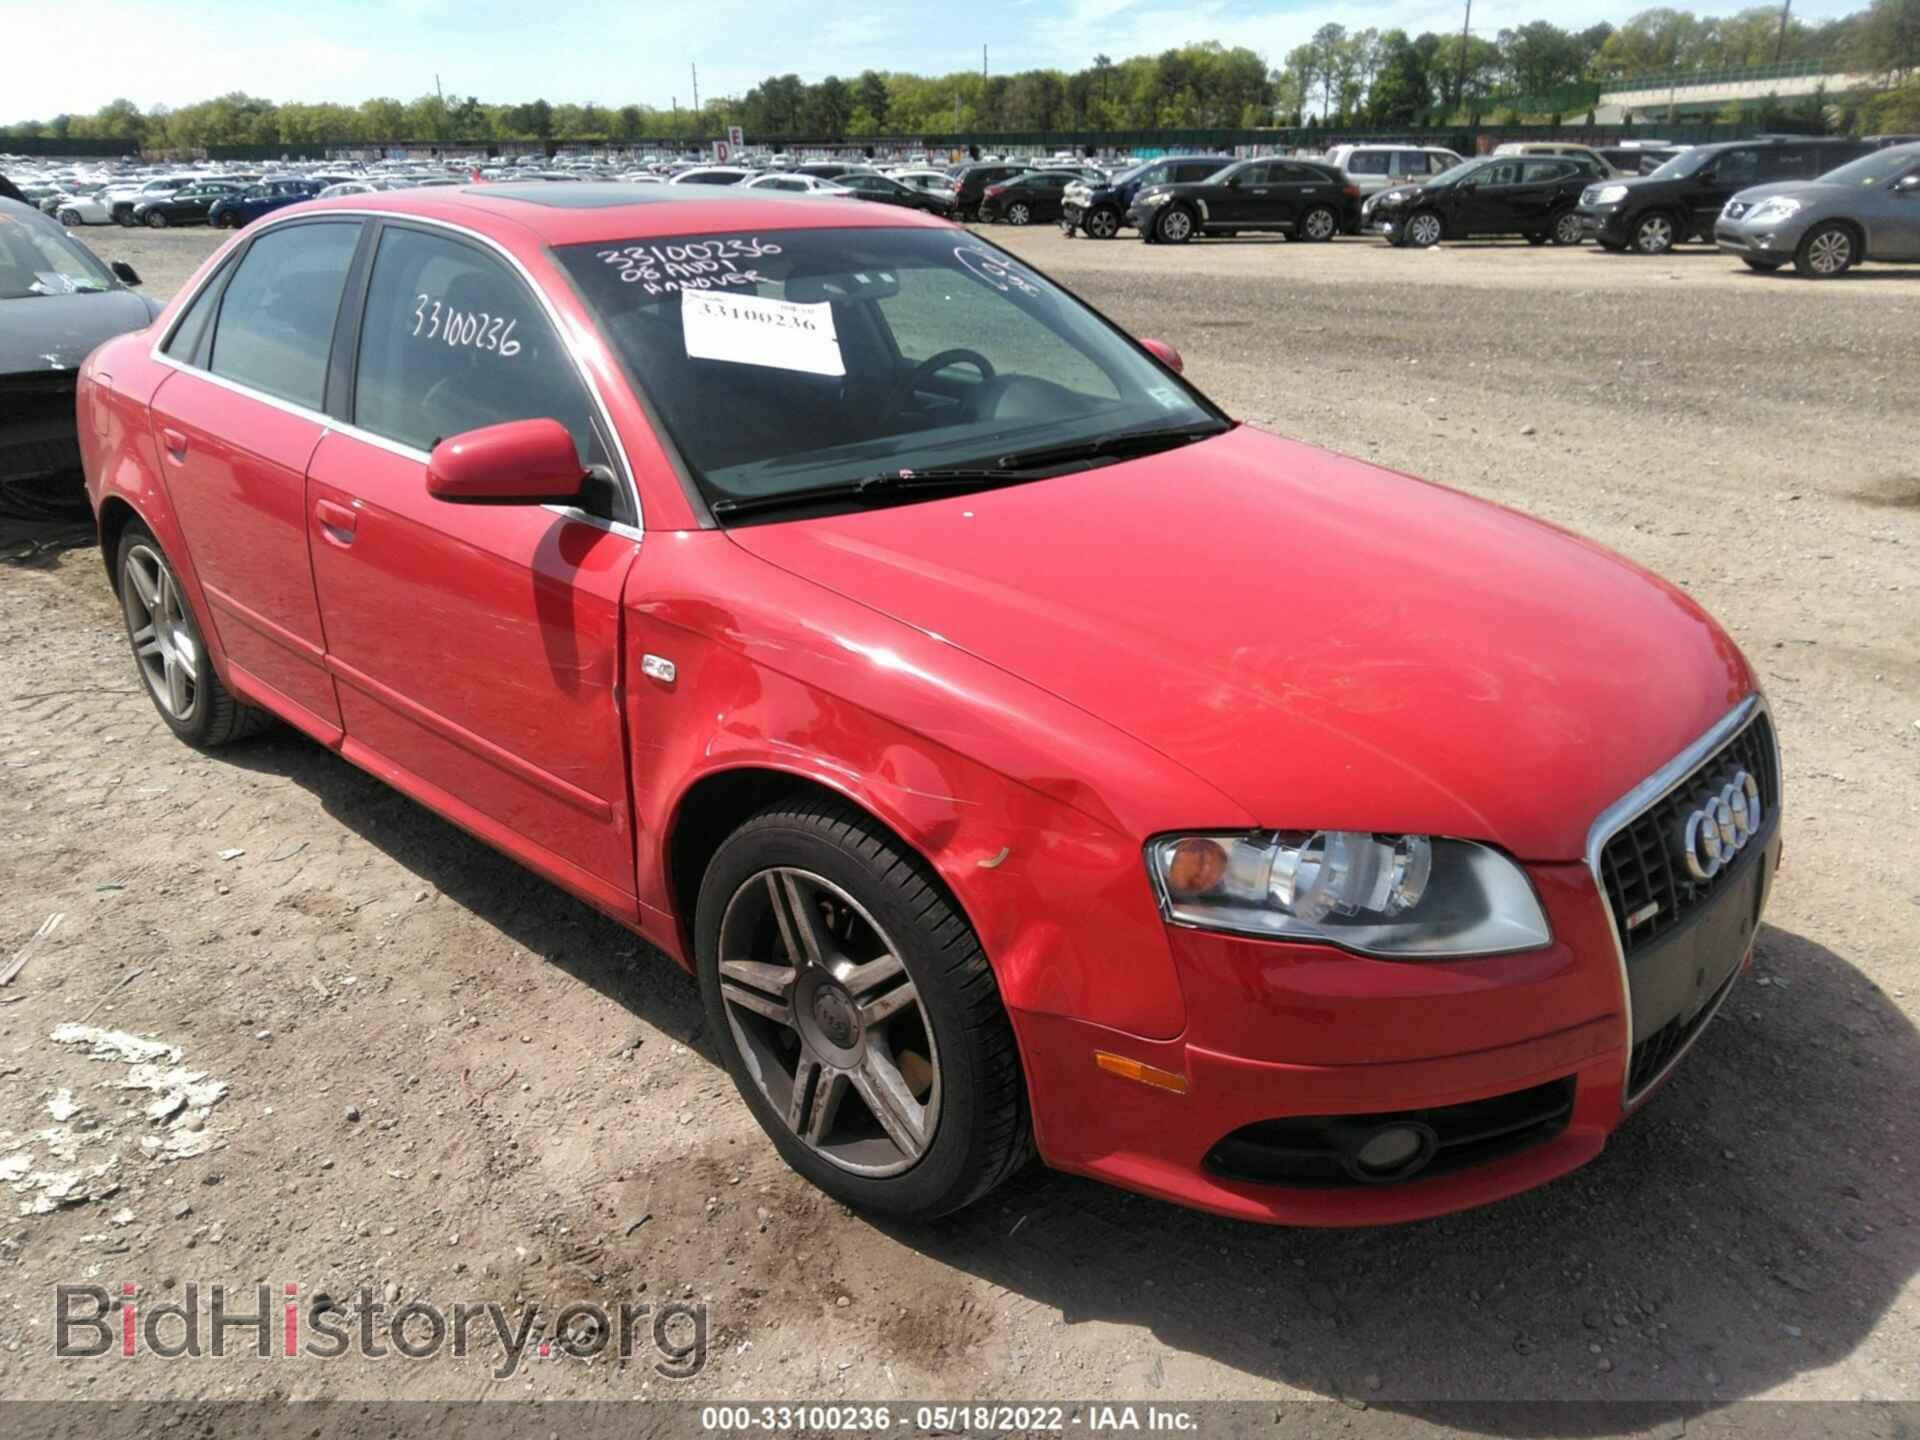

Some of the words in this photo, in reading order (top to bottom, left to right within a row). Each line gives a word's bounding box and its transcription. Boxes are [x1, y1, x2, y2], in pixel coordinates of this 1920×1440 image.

[596, 238, 783, 269] 33100236
[665, 259, 738, 278] AUDI
[412, 293, 521, 356] 33100236
[699, 302, 817, 331] 33100236
